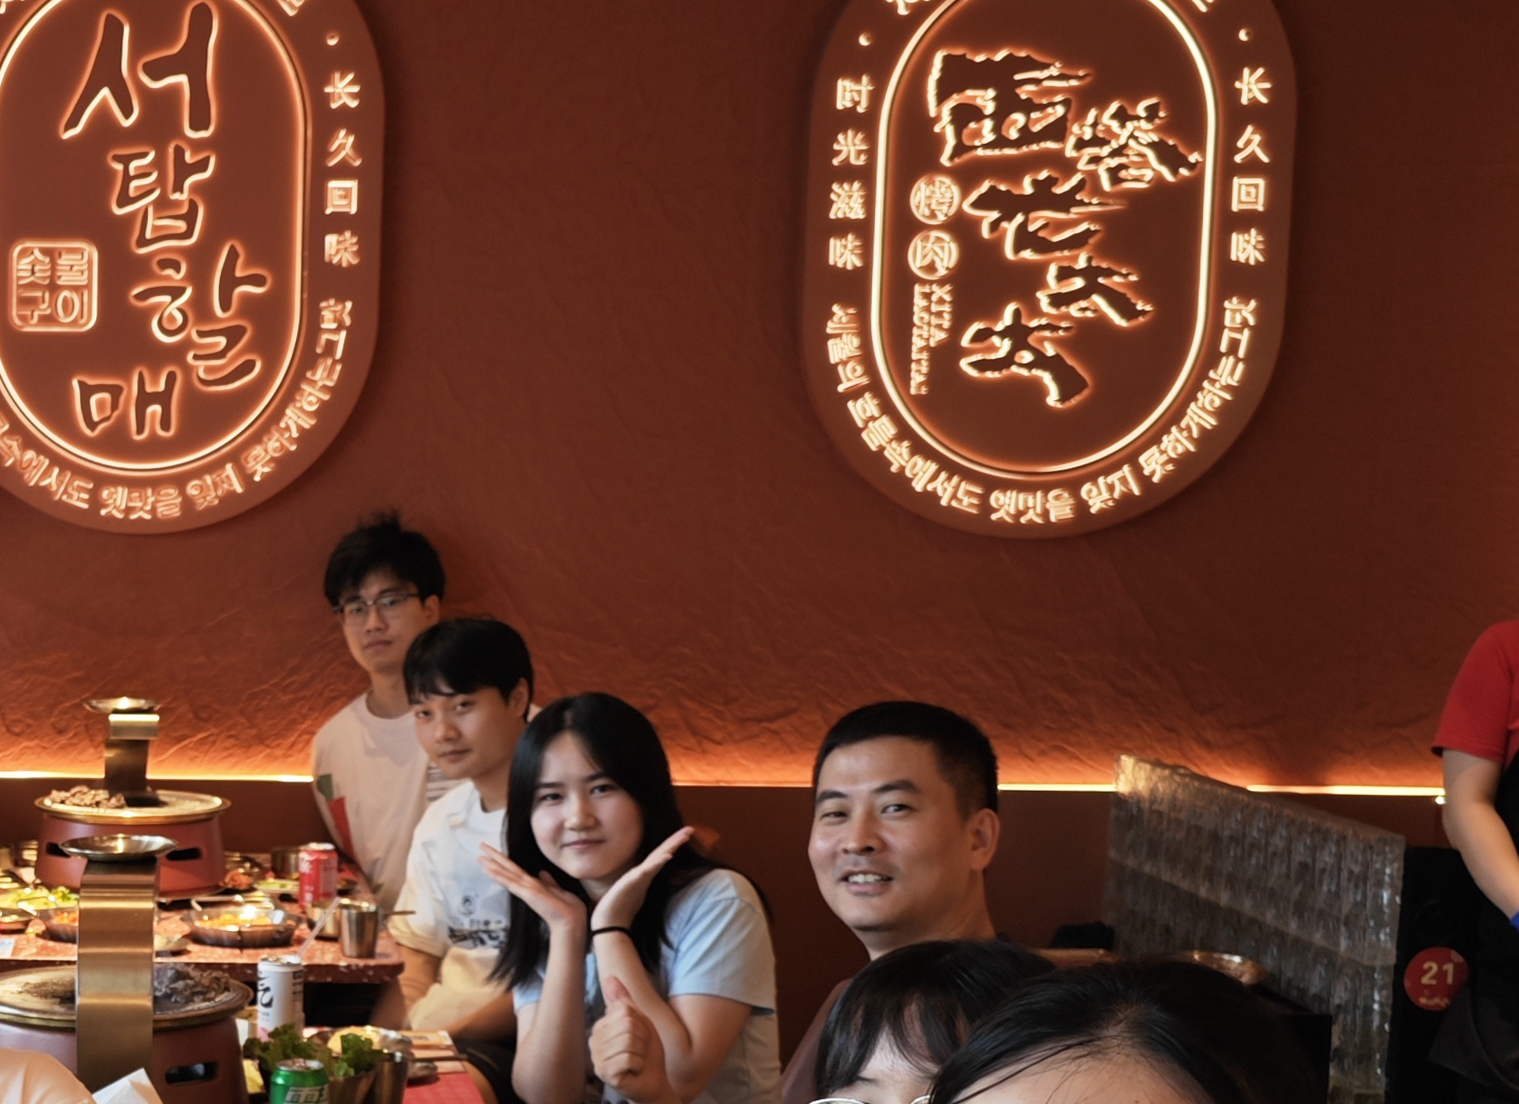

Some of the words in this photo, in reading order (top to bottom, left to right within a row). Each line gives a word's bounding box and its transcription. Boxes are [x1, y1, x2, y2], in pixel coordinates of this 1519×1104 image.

[324, 72, 362, 267] 长久回味
[828, 74, 874, 269] 时光滋味
[1230, 67, 1272, 266] 长久回味
[930, 283, 953, 347] XITA
[1421, 961, 1454, 985] 21
